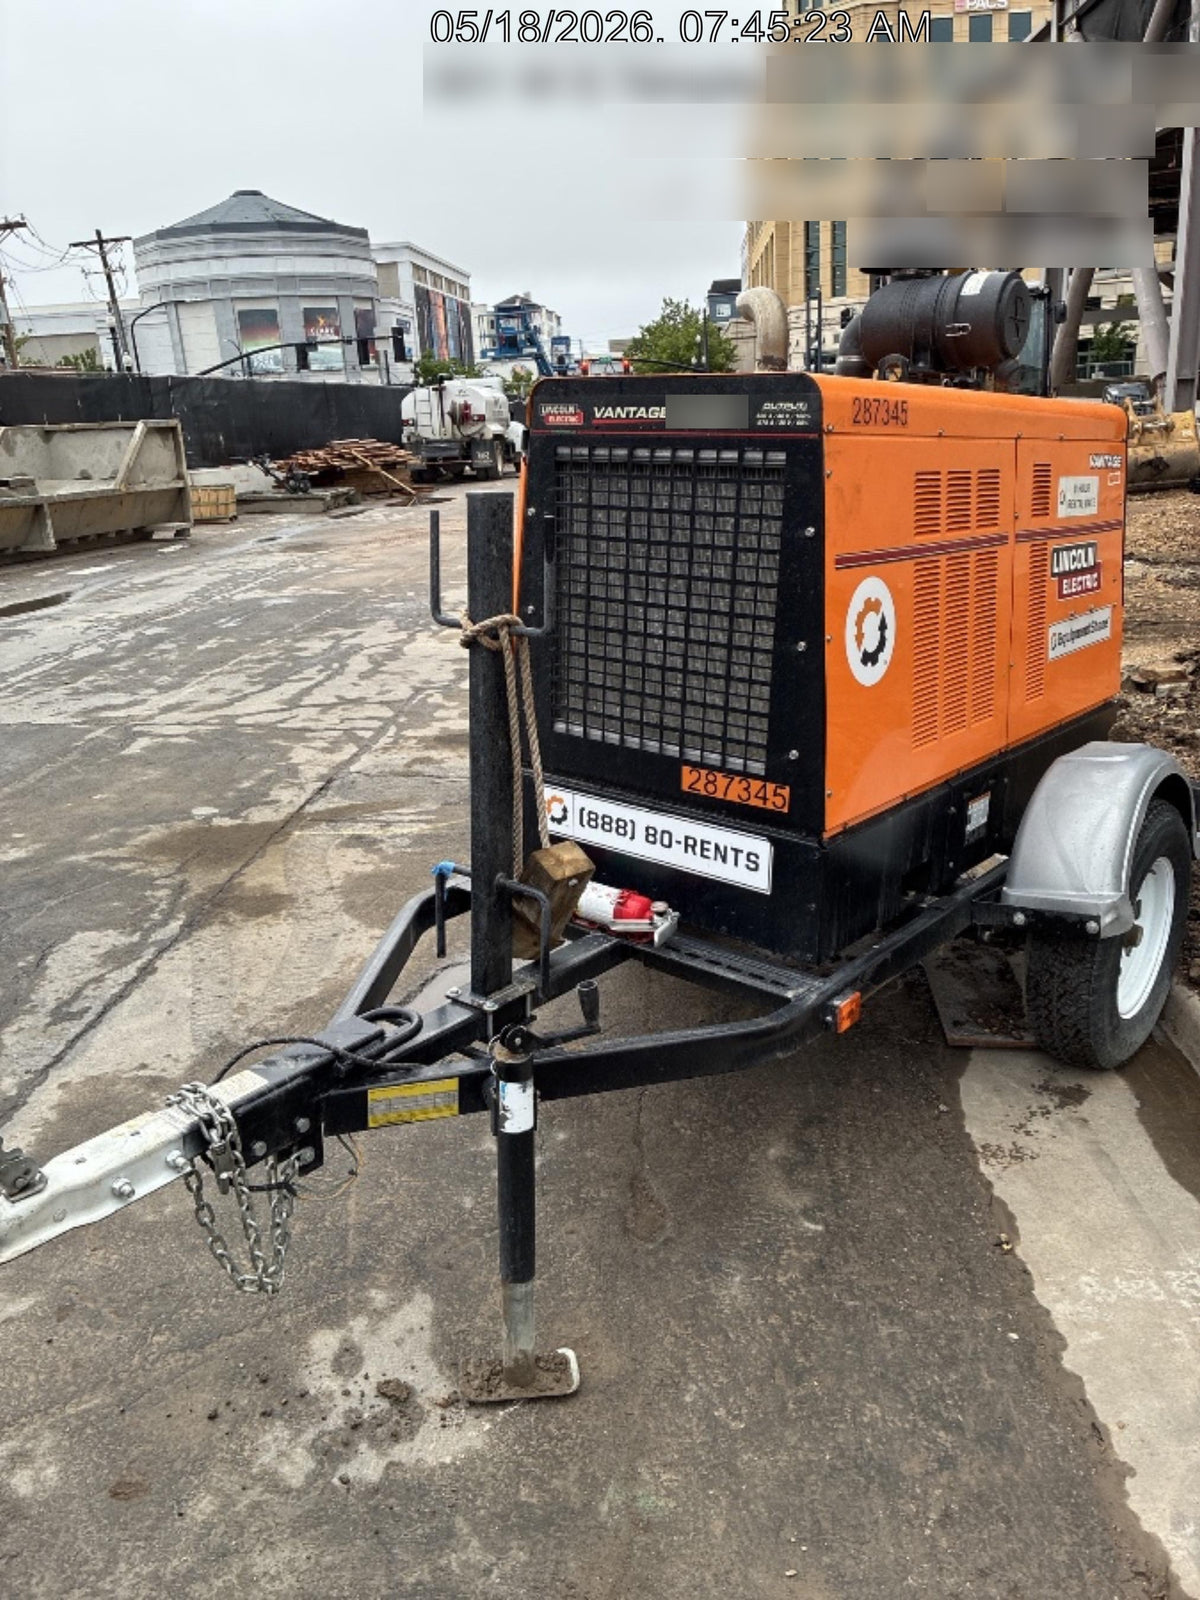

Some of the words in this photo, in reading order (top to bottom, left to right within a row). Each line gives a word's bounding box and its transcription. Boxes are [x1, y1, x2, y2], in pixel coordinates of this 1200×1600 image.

[541, 404, 576, 415] LINCOLN
[548, 414, 580, 424] ELECTRIC
[852, 396, 909, 427] 287345
[1052, 546, 1095, 574] LINCOLN
[1062, 571, 1099, 595] ELECTRIC
[687, 768, 788, 810] 287345
[578, 806, 636, 842] (888)
[644, 824, 761, 873] 80-RENTS
